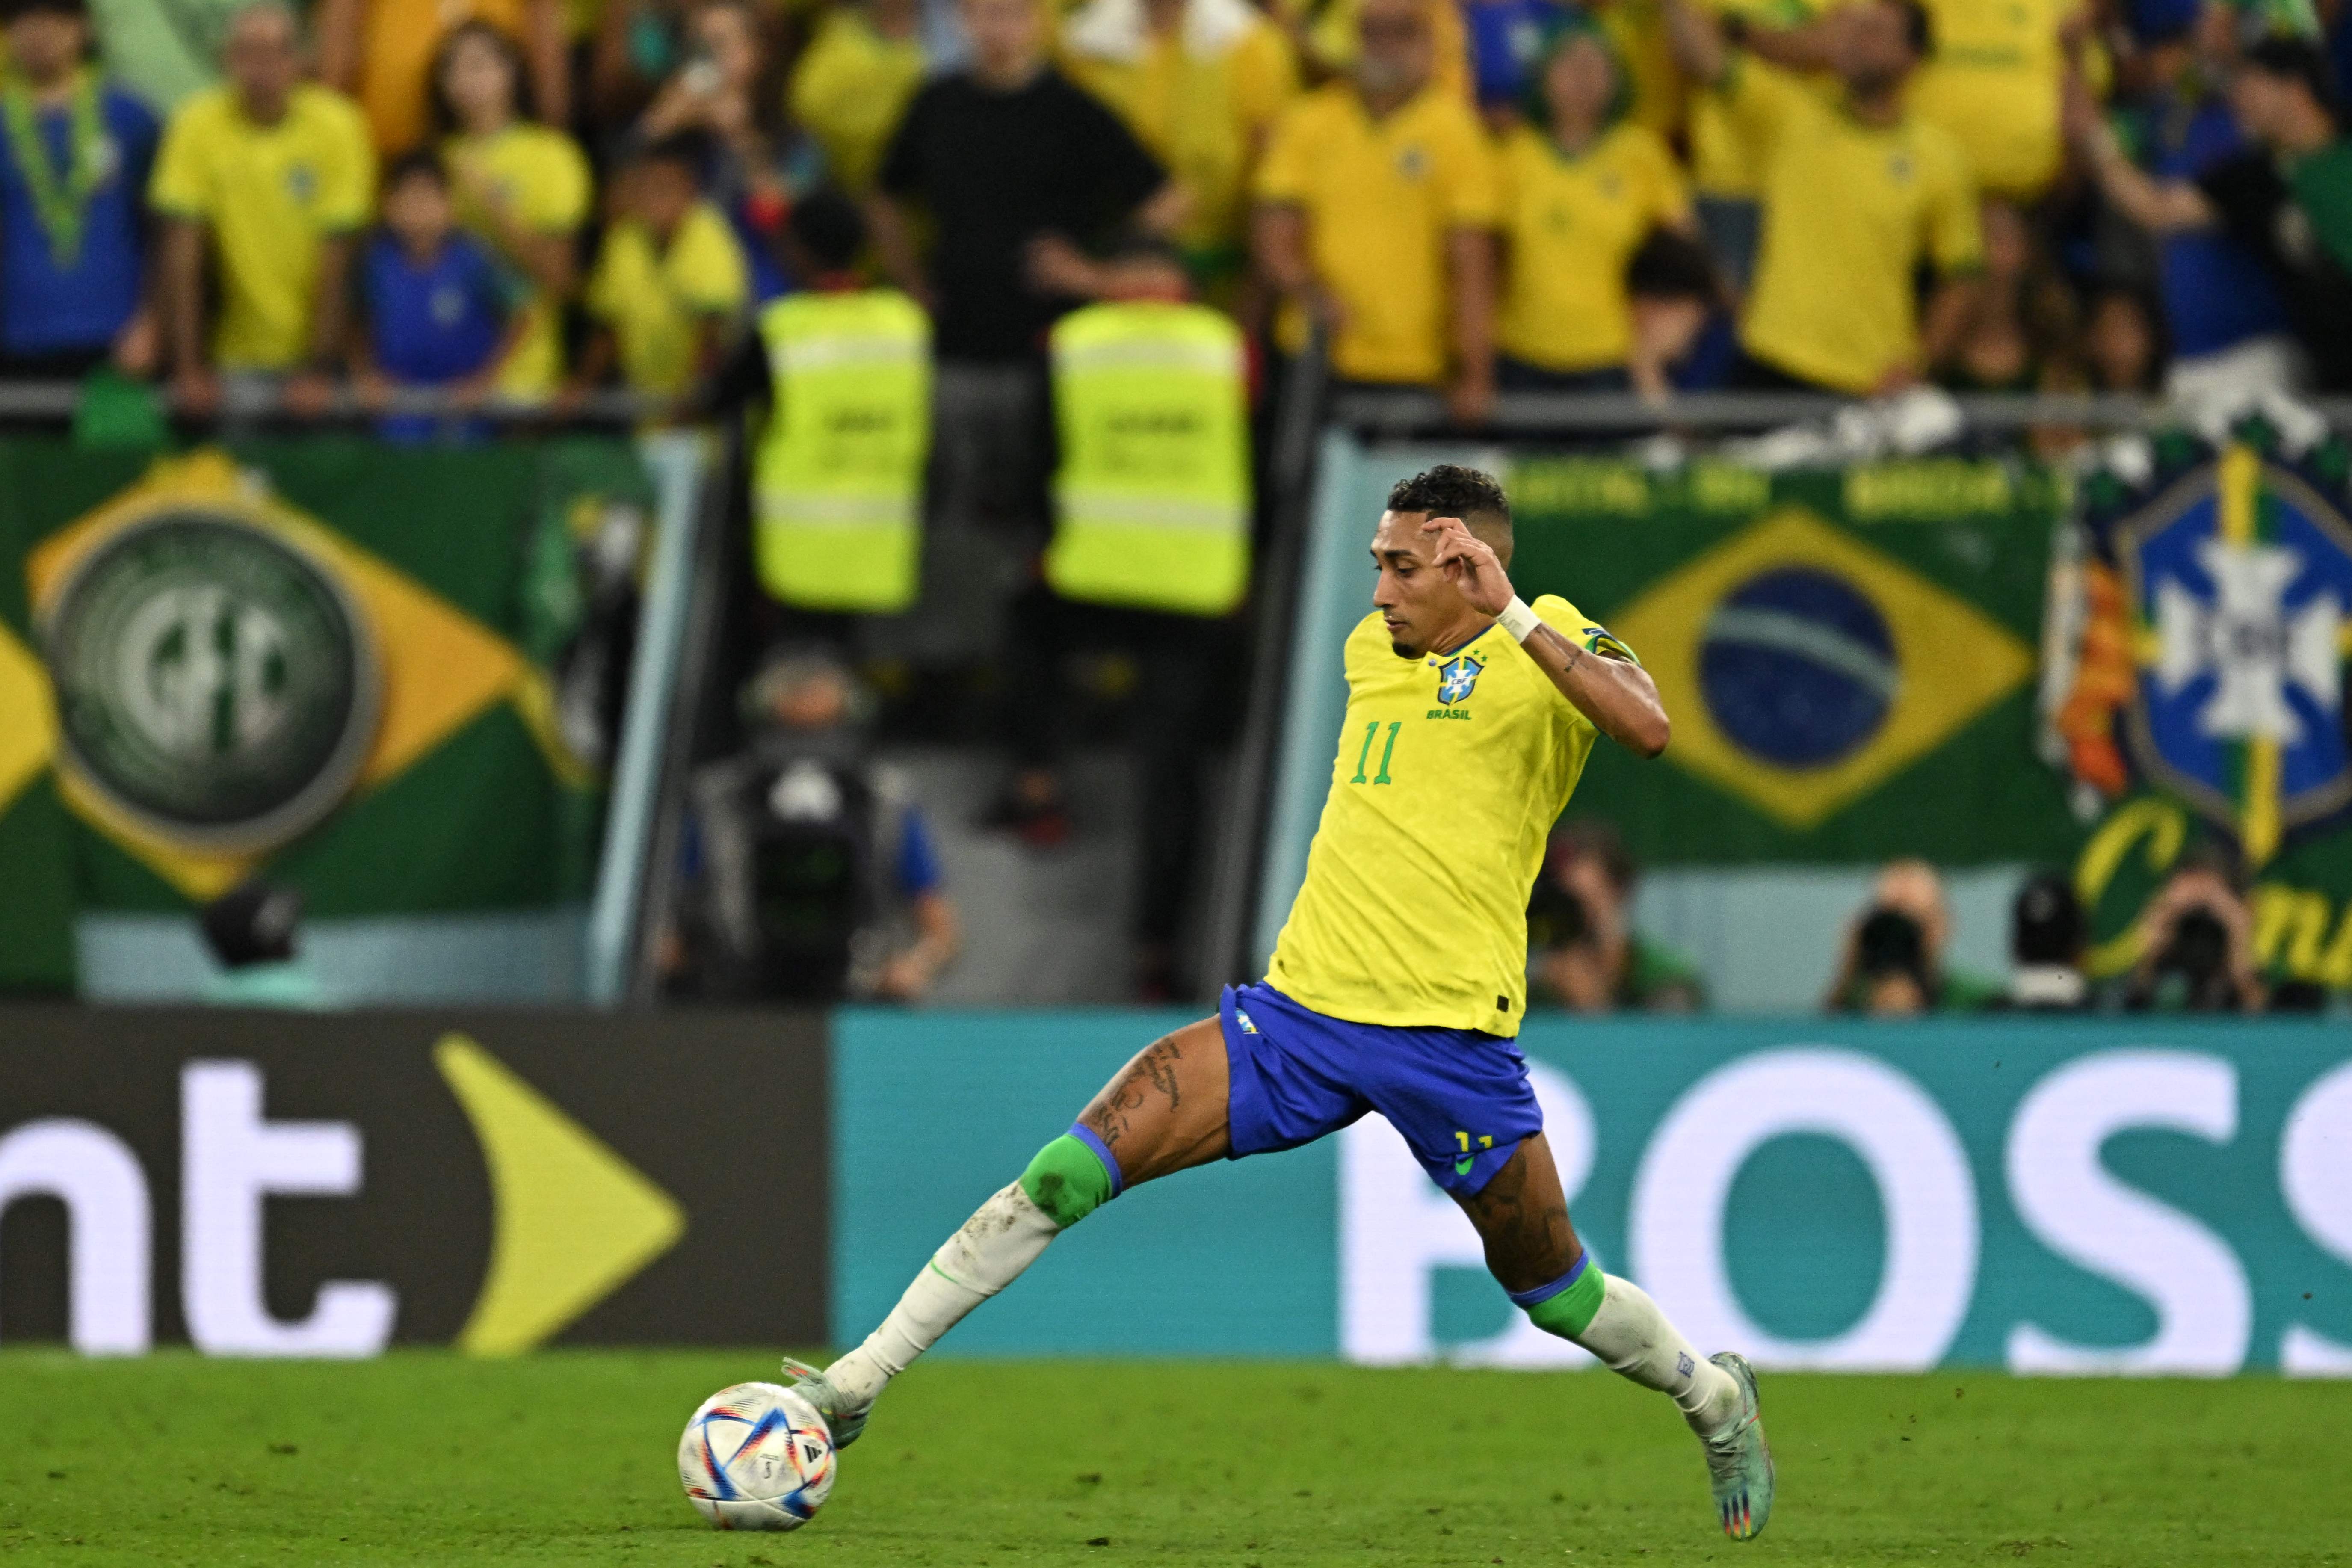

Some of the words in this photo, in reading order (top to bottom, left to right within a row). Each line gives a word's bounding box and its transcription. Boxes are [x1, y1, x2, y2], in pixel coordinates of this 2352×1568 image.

[1426, 709, 1472, 720] BRASIL
[1350, 721, 1402, 785] 11
[1338, 1046, 2352, 1376] BOS
